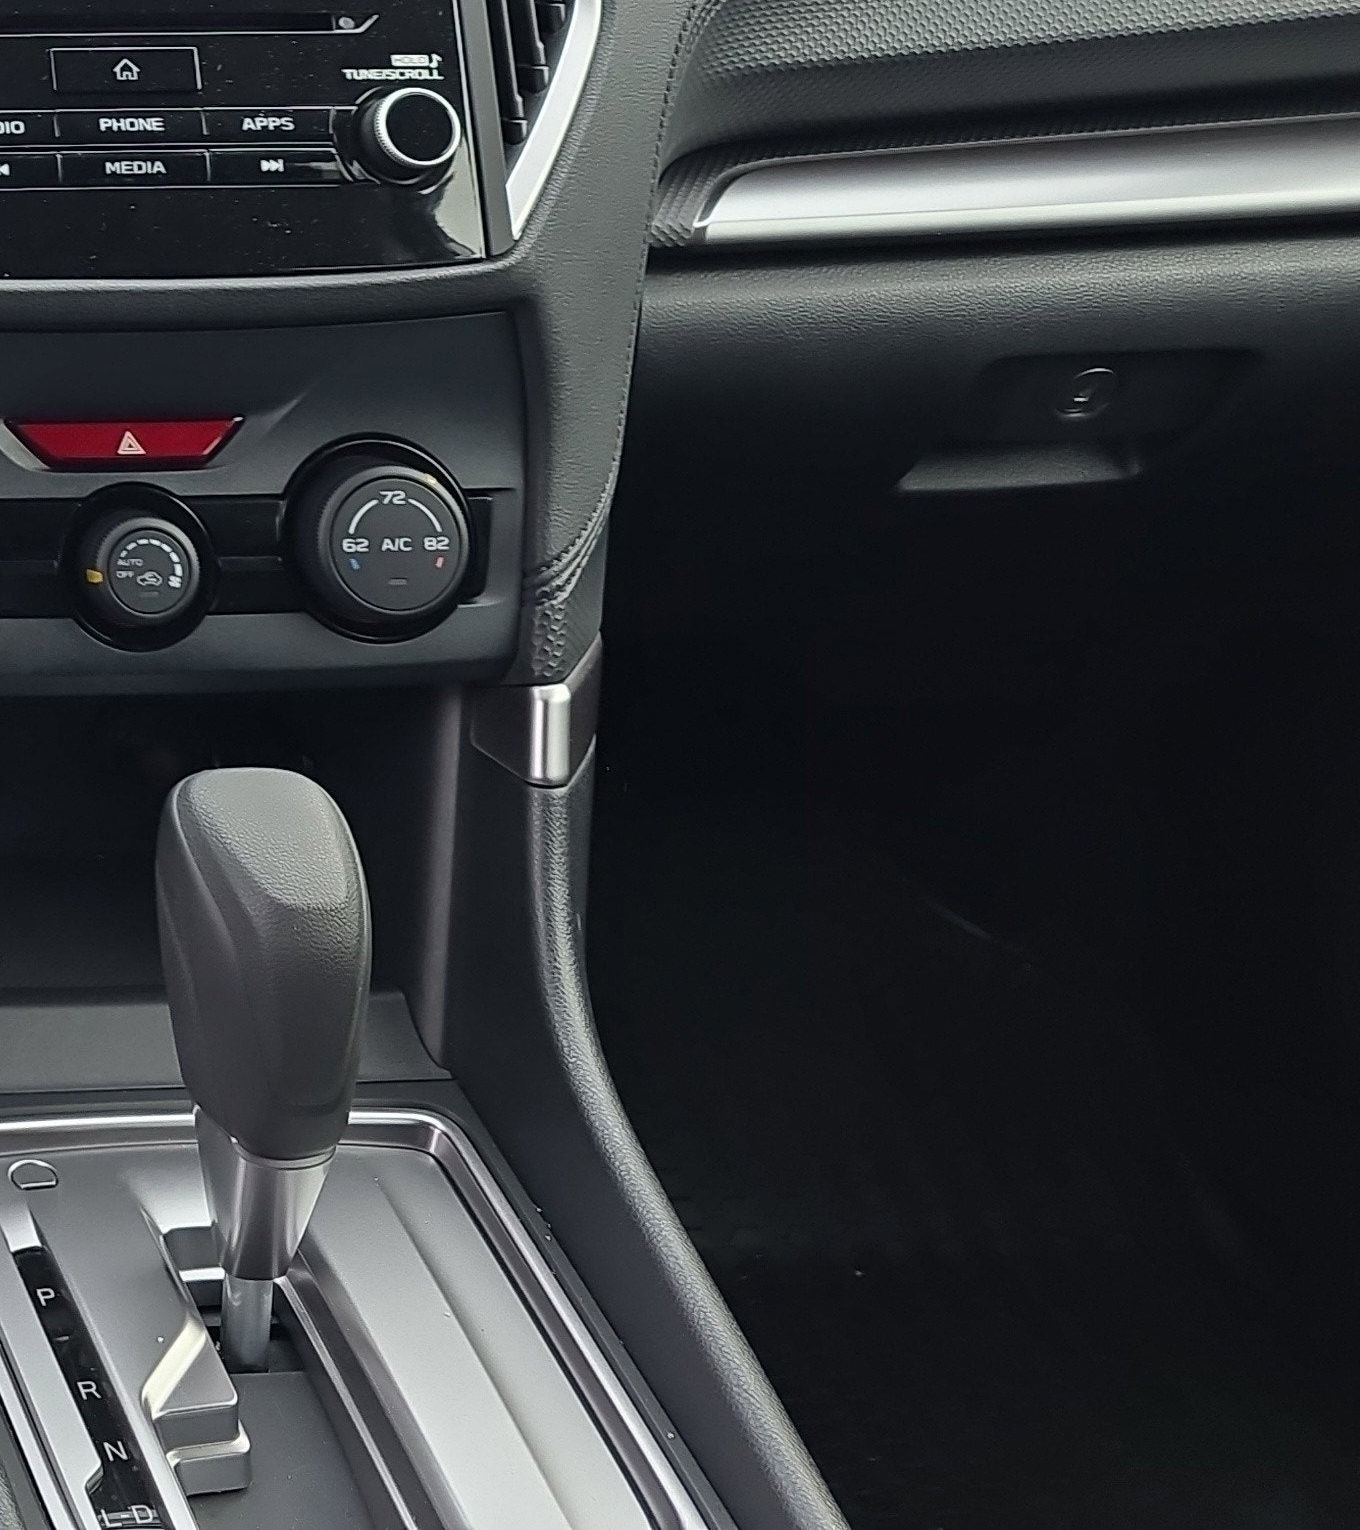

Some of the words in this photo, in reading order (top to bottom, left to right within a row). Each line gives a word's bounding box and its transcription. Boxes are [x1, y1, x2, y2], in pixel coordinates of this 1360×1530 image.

[341, 68, 445, 81] TUNE/SCROLL
[98, 116, 165, 133] PHONE
[241, 116, 295, 132] APPS
[104, 160, 167, 176] MEDIA
[379, 490, 407, 505] 72
[342, 538, 370, 553] 62
[381, 537, 413, 552] A/C
[423, 536, 450, 551] 82
[116, 558, 144, 567] AUTO
[116, 570, 135, 579] OFF
[35, 1287, 56, 1307] P
[76, 1380, 103, 1401] R
[102, 1440, 130, 1463] N
